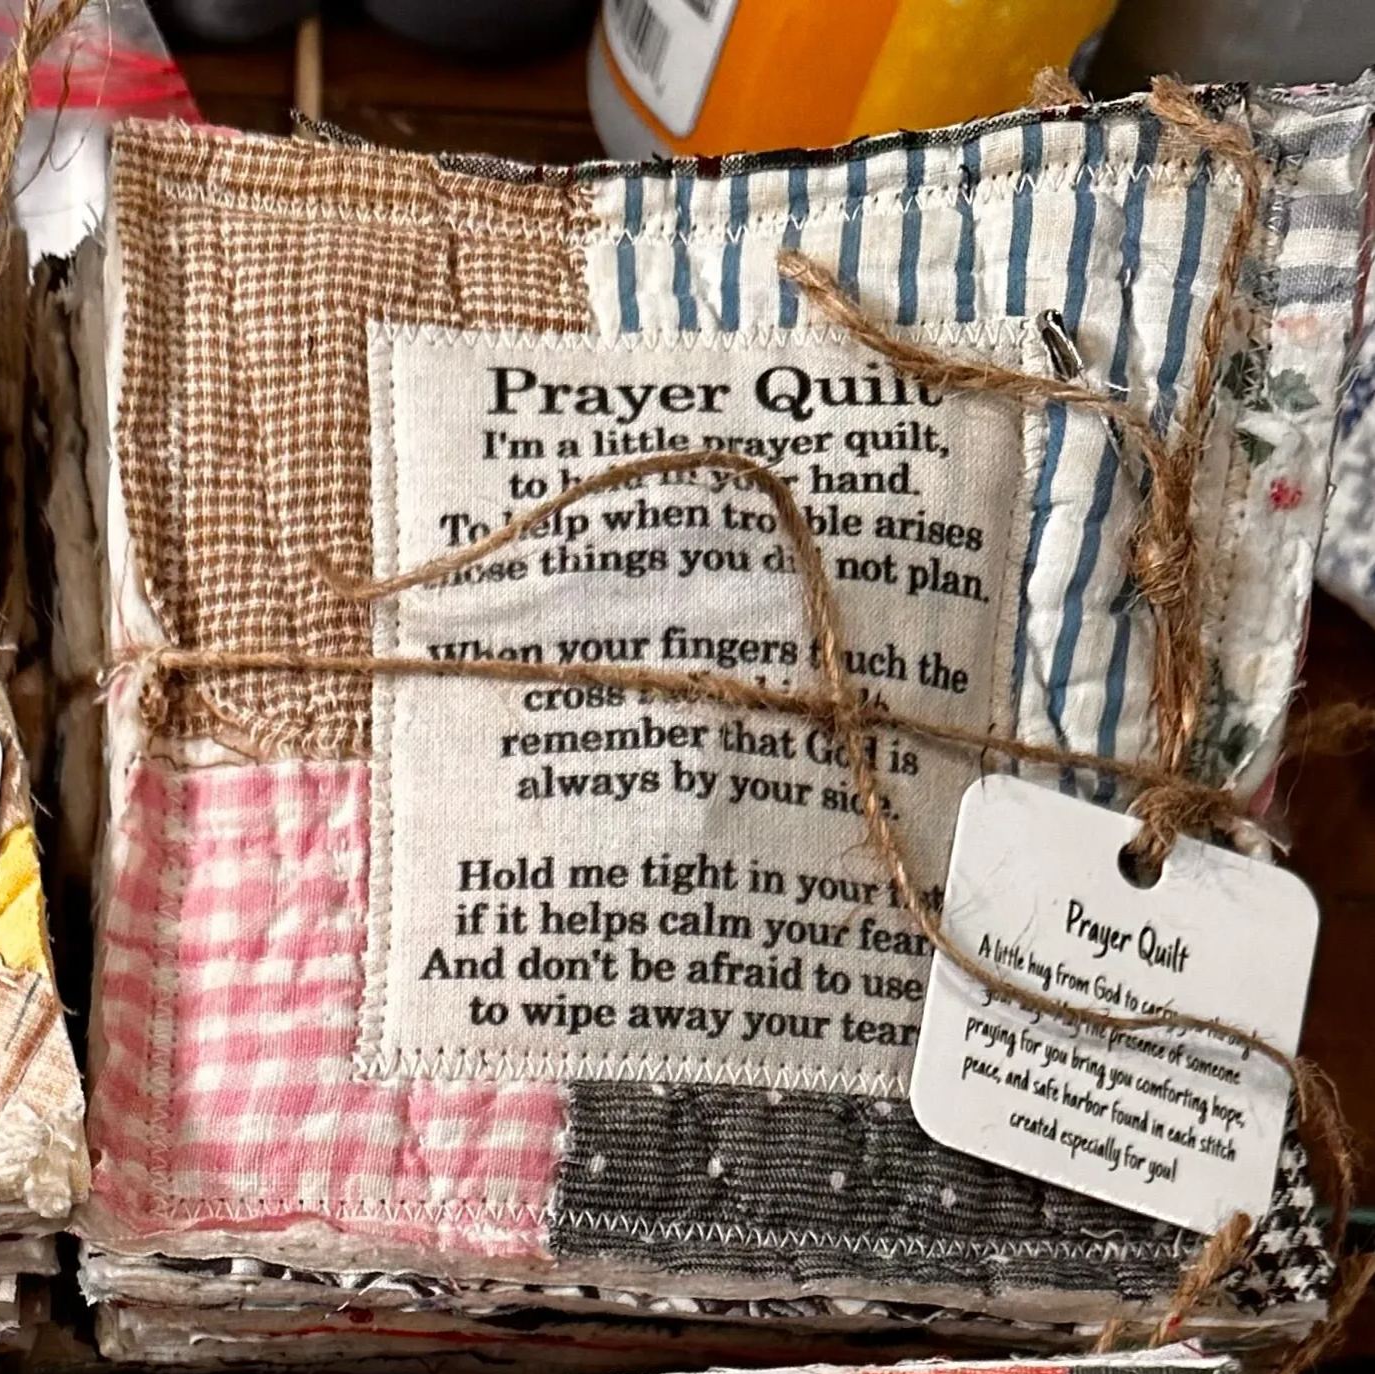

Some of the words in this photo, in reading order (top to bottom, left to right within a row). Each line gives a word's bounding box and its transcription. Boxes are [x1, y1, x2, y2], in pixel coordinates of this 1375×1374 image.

[486, 367, 731, 426] Prayer
[482, 431, 545, 461] I'm
[554, 434, 580, 458] a
[593, 423, 690, 455] little
[701, 427, 832, 463] prayer
[844, 422, 951, 461] quilt,
[457, 859, 555, 892] Hold
[568, 862, 629, 890] me
[640, 854, 738, 894] tight
[747, 862, 785, 895] in
[796, 870, 879, 906] your
[455, 904, 486, 936] if
[493, 904, 527, 935] it
[539, 901, 648, 939] helps
[658, 903, 752, 940] calm
[762, 909, 849, 948] your
[858, 917, 935, 957] fear
[1066, 899, 1132, 958] Prayer
[1138, 925, 1188, 972] Quilt
[468, 997, 510, 1025] to
[523, 995, 616, 1031] wipe
[628, 1001, 728, 1036] away
[742, 1005, 830, 1041] your
[840, 1012, 921, 1047] tear
[961, 1056, 1000, 1083] peace,
[1005, 1069, 1029, 1090] and
[1033, 1077, 1058, 1101] safe
[1062, 1082, 1108, 1116] harbor
[1111, 1100, 1148, 1132] found
[1151, 1123, 1164, 1138] in
[1167, 1126, 1196, 1148] each
[1200, 1136, 1235, 1160] stitch
[1009, 1113, 1057, 1140] created
[1060, 1131, 1121, 1171] especially
[1124, 1144, 1146, 1169] for
[1145, 1158, 1177, 1183] you!
